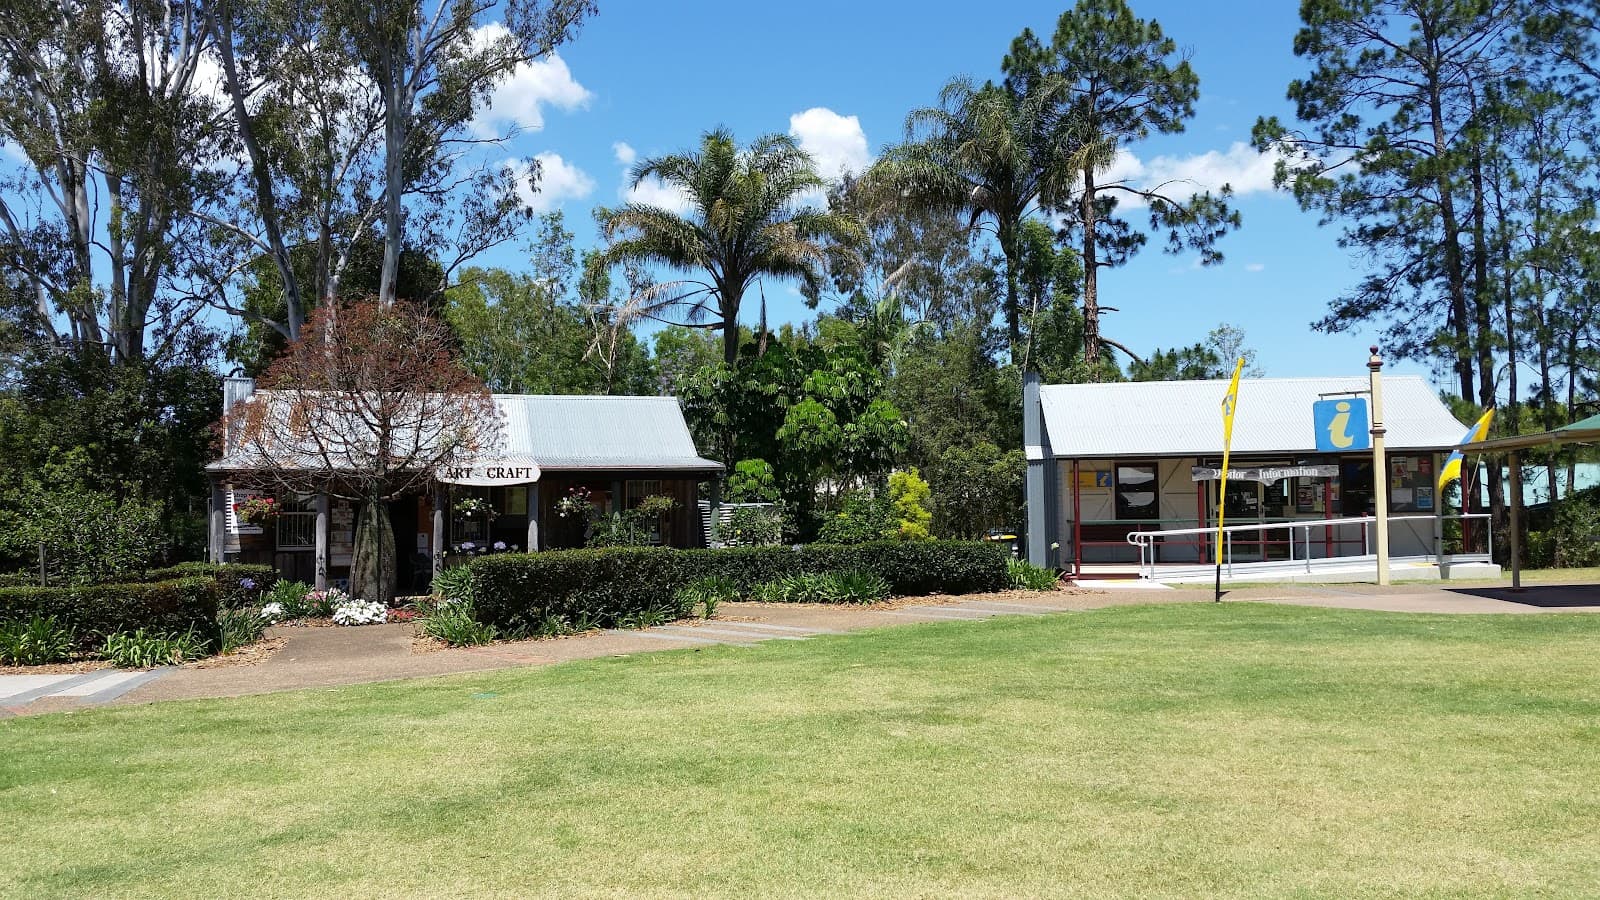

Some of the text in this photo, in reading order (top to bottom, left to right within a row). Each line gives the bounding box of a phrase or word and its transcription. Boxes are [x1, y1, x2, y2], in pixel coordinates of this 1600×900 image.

[445, 467, 532, 479] ART CRAFT
[1211, 466, 1318, 479] Vsitor Information
